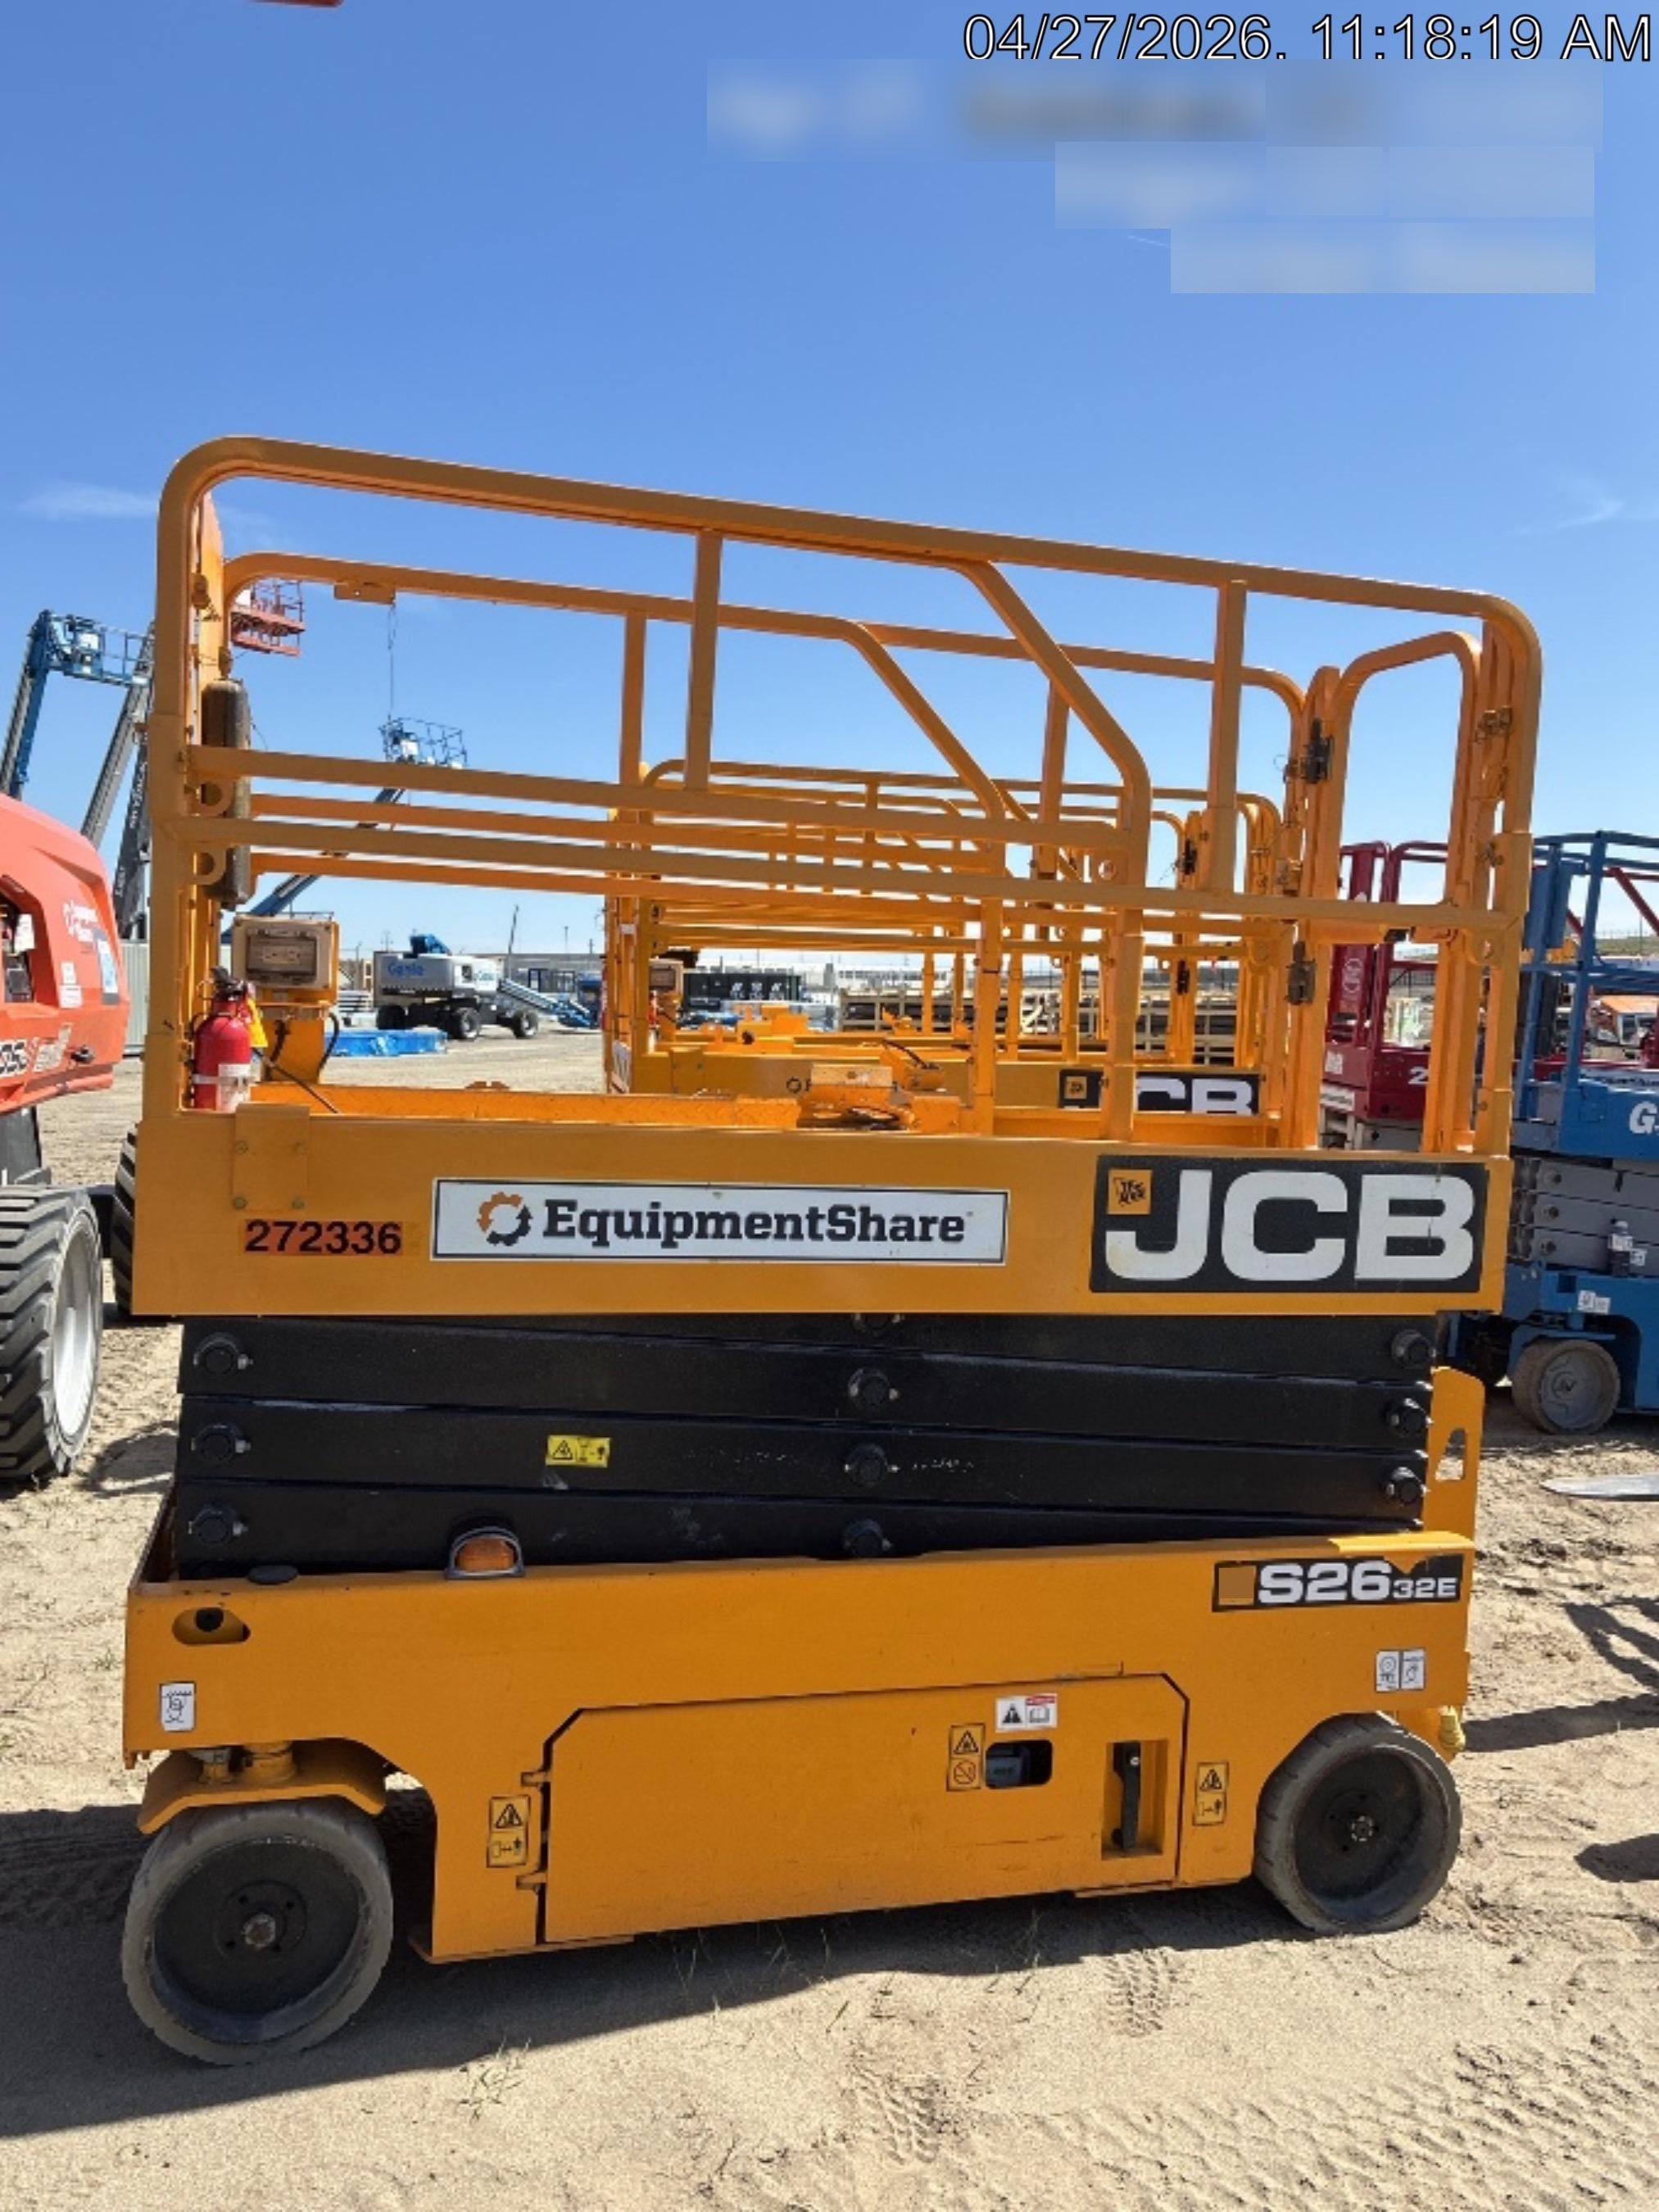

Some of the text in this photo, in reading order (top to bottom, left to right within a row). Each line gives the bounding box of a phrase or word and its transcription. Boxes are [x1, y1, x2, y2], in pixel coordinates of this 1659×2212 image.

[1629, 1101, 1659, 1135] G
[245, 1219, 402, 1254] 272336
[543, 1199, 966, 1249] EquipmentShare
[1104, 1169, 1475, 1281] JCB
